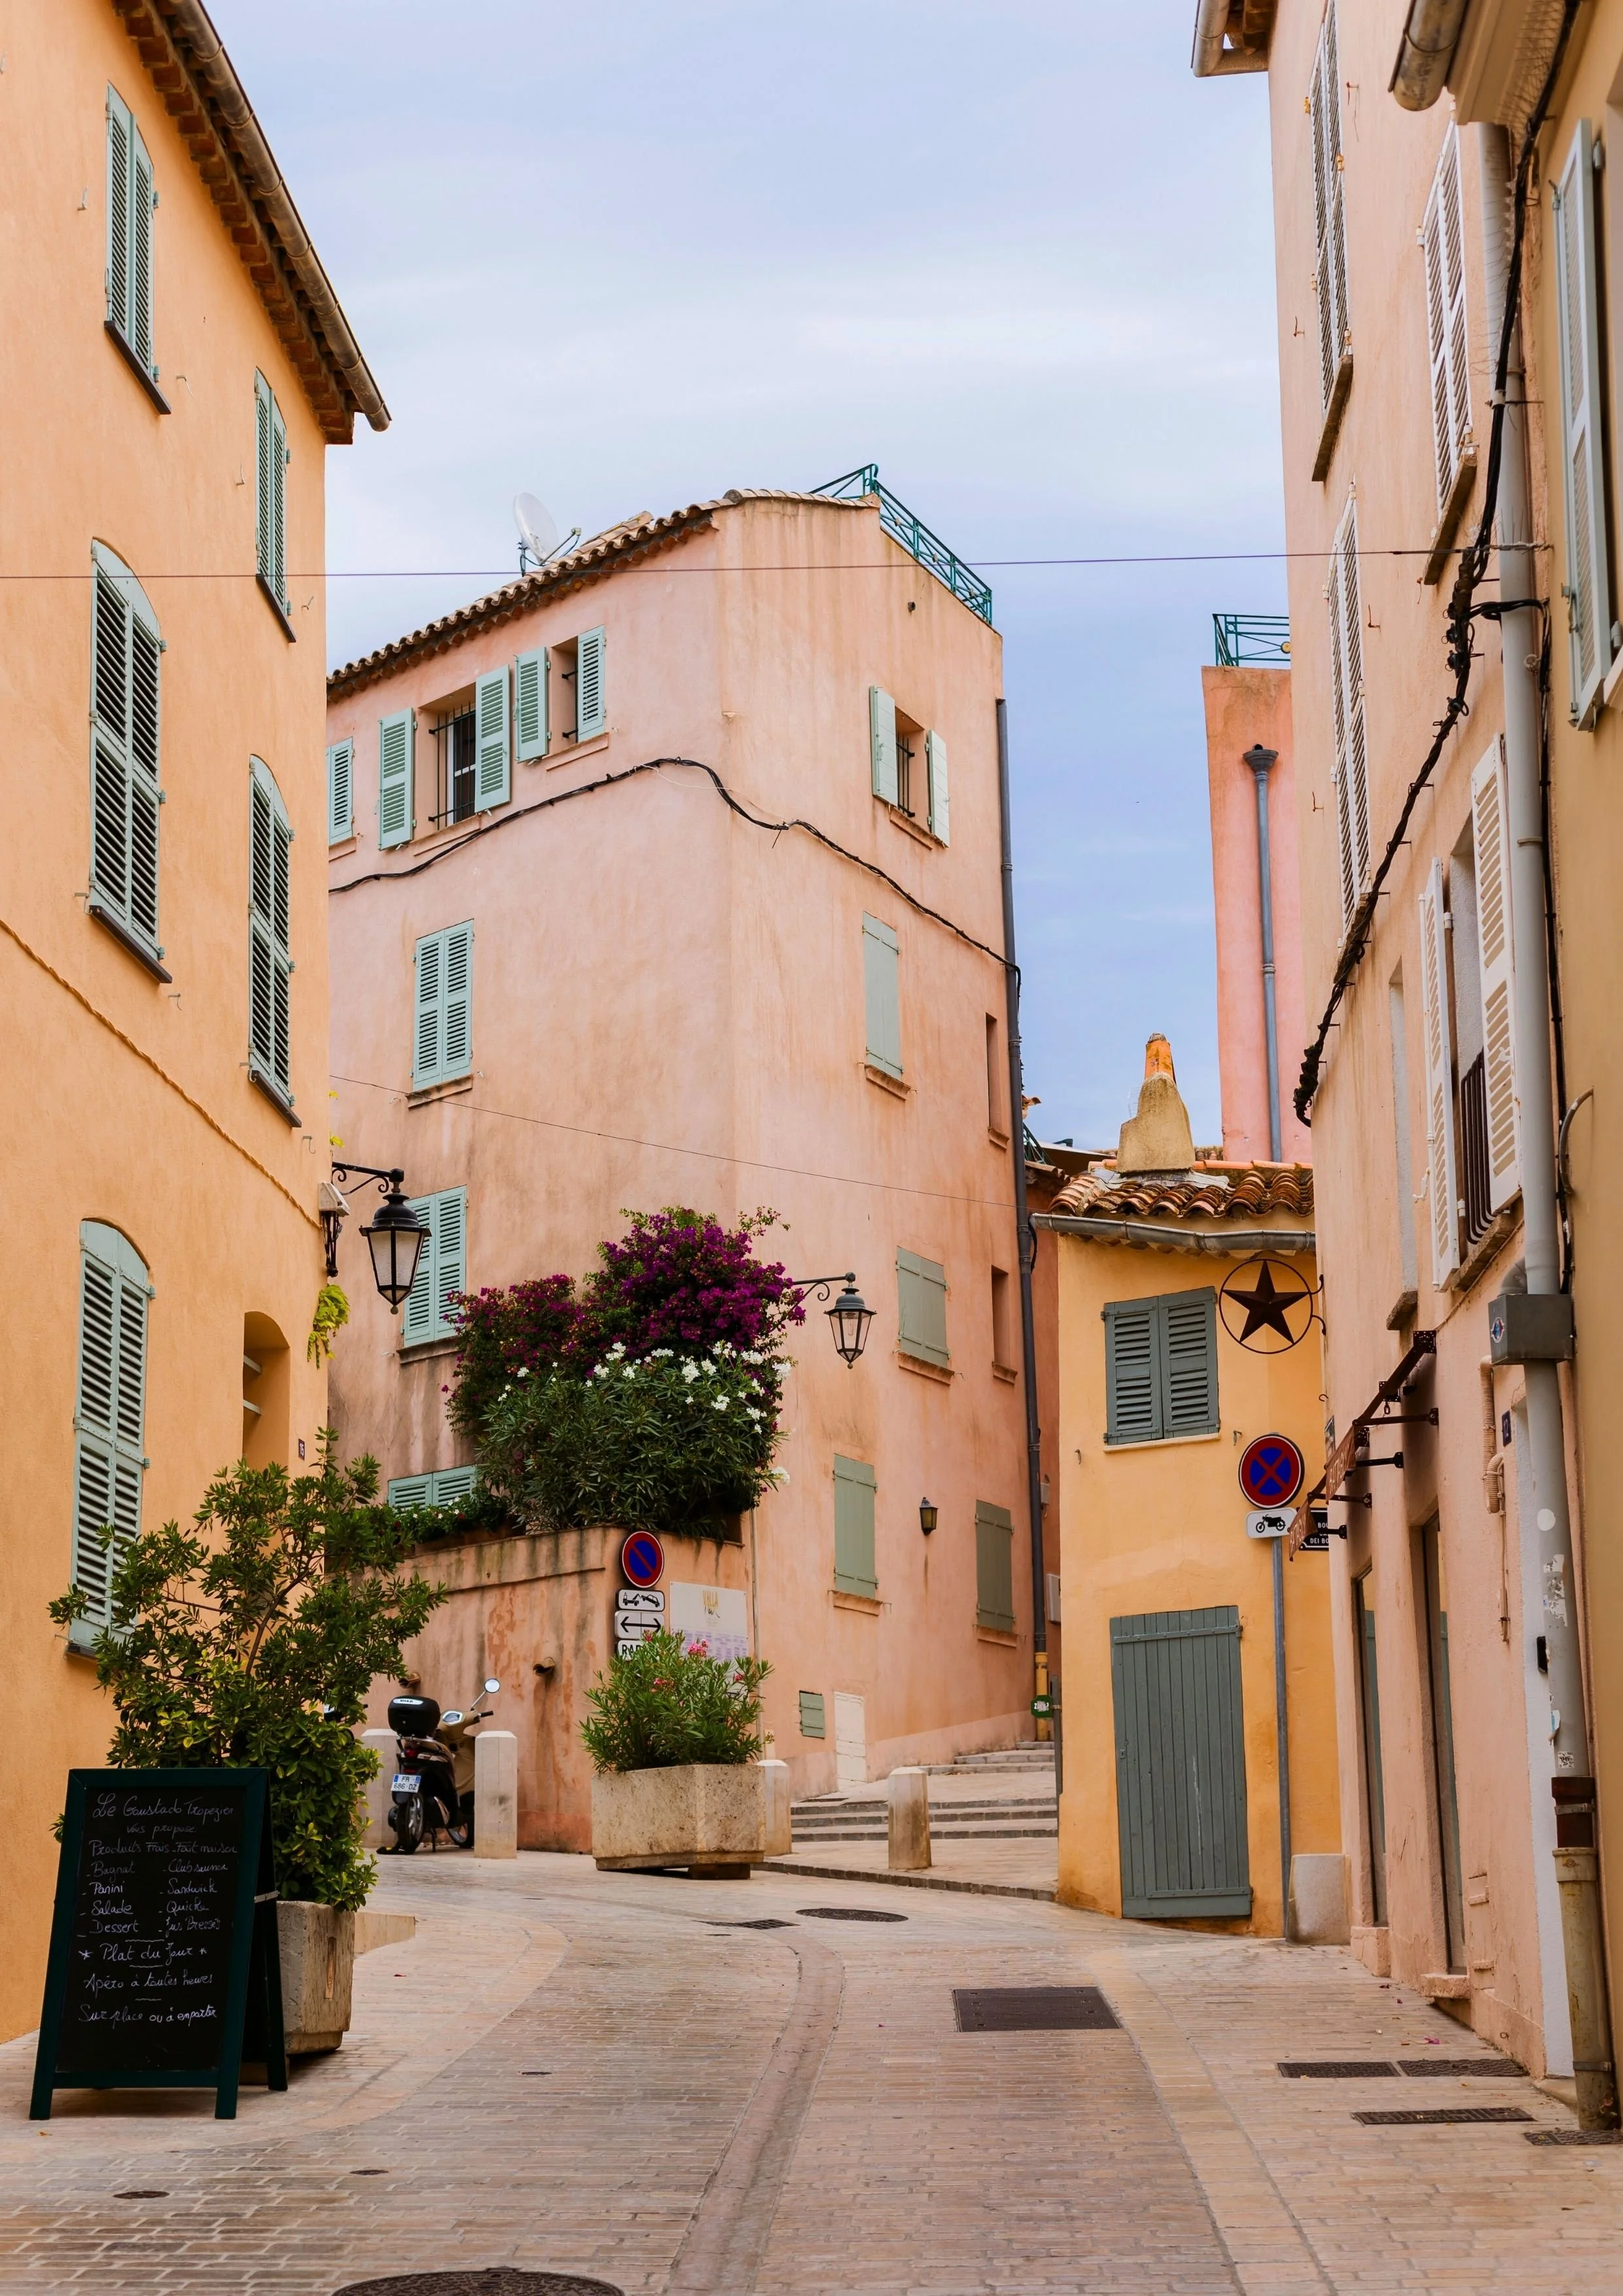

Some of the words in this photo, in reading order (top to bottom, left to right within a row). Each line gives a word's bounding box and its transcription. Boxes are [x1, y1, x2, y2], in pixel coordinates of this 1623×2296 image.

[1503, 1418, 1509, 1438] 12
[92, 1793, 116, 1818] Le
[89, 1838, 141, 1857] Produits
[200, 1842, 238, 1854] maison
[91, 1861, 136, 1883] Bagnat
[168, 1859, 192, 1873] Club
[89, 1880, 125, 1895] Panini
[92, 1899, 134, 1916] Salade
[89, 1918, 139, 1933] Dessert
[99, 1943, 135, 1962] Plat
[141, 1945, 161, 1959] du
[144, 1970, 177, 1986] toutes
[183, 1969, 213, 1986] heures
[78, 2003, 107, 2022] Sur
[110, 2005, 143, 2030] place
[149, 2014, 163, 2023] ou
